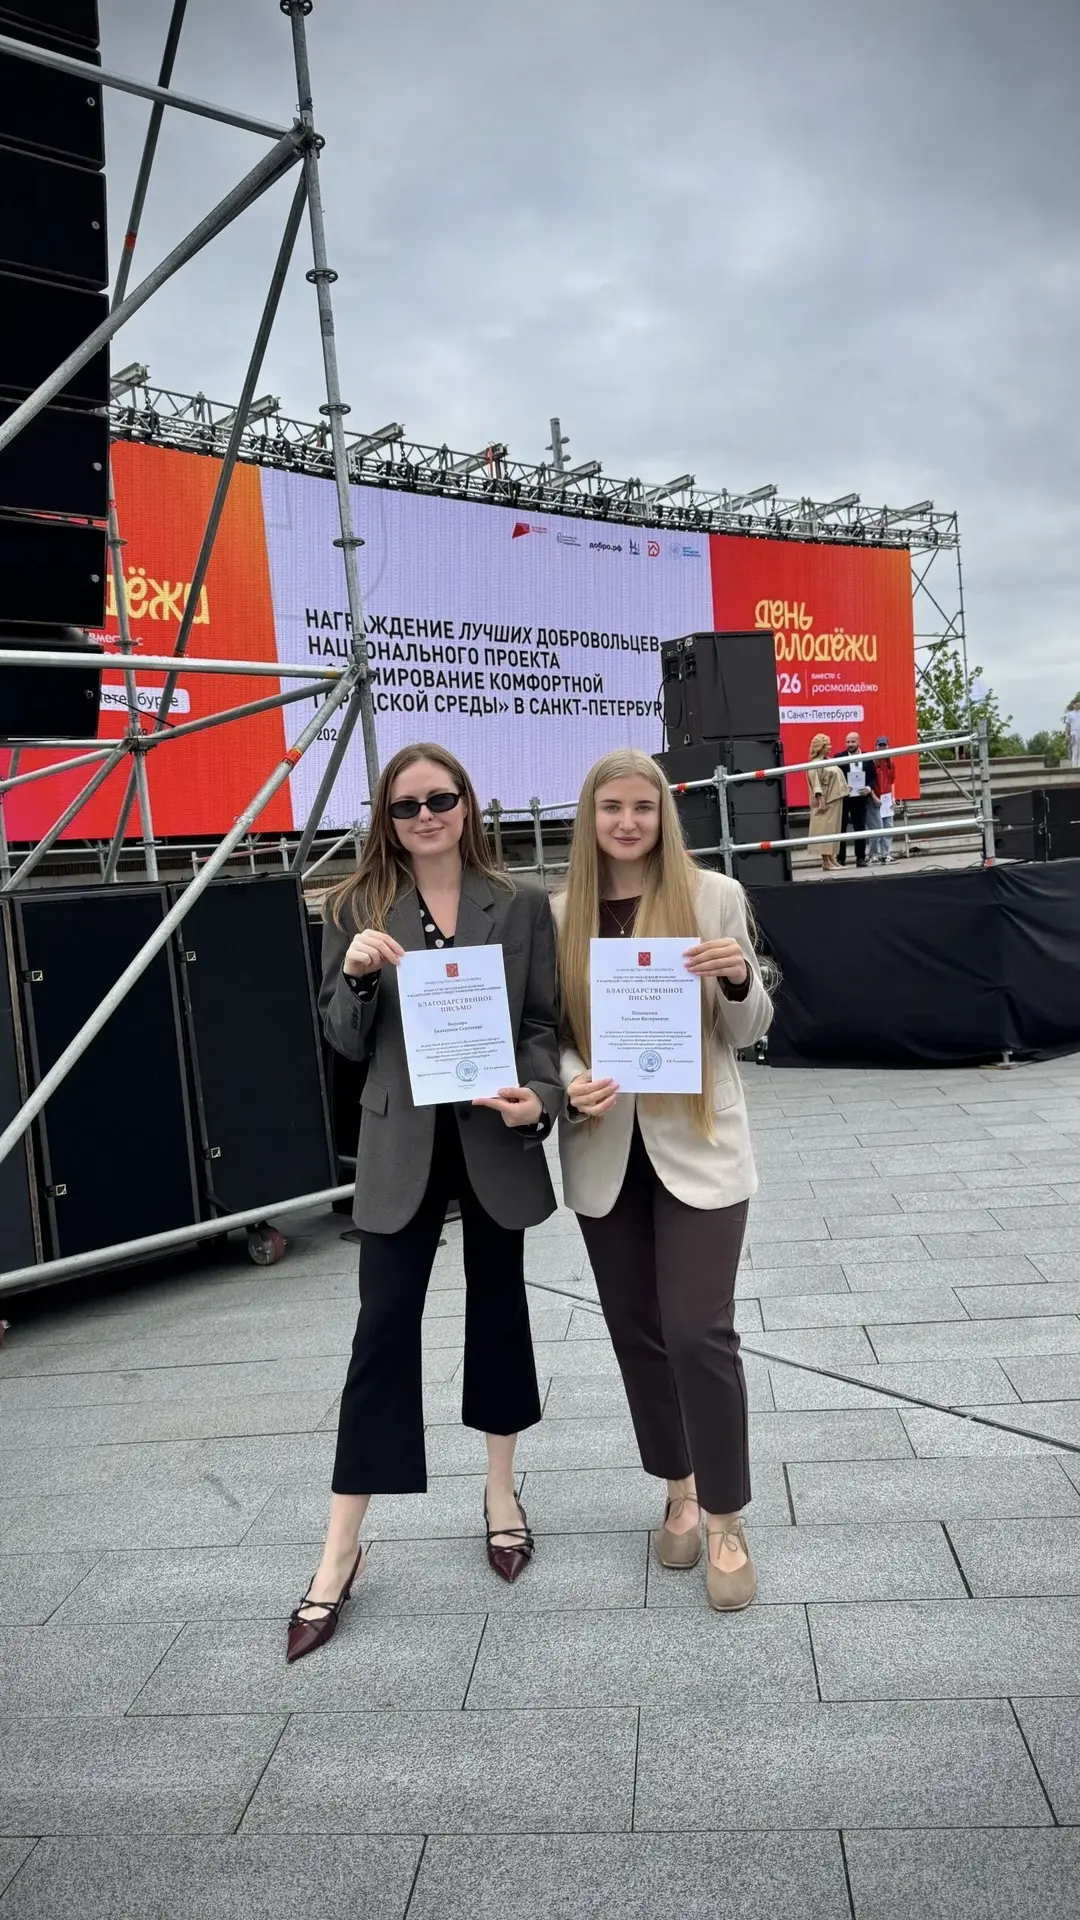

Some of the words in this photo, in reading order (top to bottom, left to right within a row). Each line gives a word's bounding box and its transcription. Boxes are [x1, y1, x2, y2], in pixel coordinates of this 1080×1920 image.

[458, 622, 533, 645] ЛУЧШИХ
[536, 628, 661, 654] ДОБРОВОЛЬЦЕВ
[774, 627, 879, 662] олодёжи
[308, 635, 479, 665] НАЦОНАЛЬНОГО
[484, 648, 561, 669] ПРОЕКТА
[490, 672, 604, 694] КОМФОРТНОЙ
[434, 694, 509, 717] СРЕДЫ»
[514, 697, 525, 715] В
[529, 697, 663, 717] САНКТ-ПЕТЕРБУР
[787, 709, 858, 720] Санкт-Петербурге
[316, 728, 338, 741] 202
[417, 996, 493, 1008] БЛАГОДАРСТВЕННОЕ
[440, 1004, 472, 1013] ПИСЬМО
